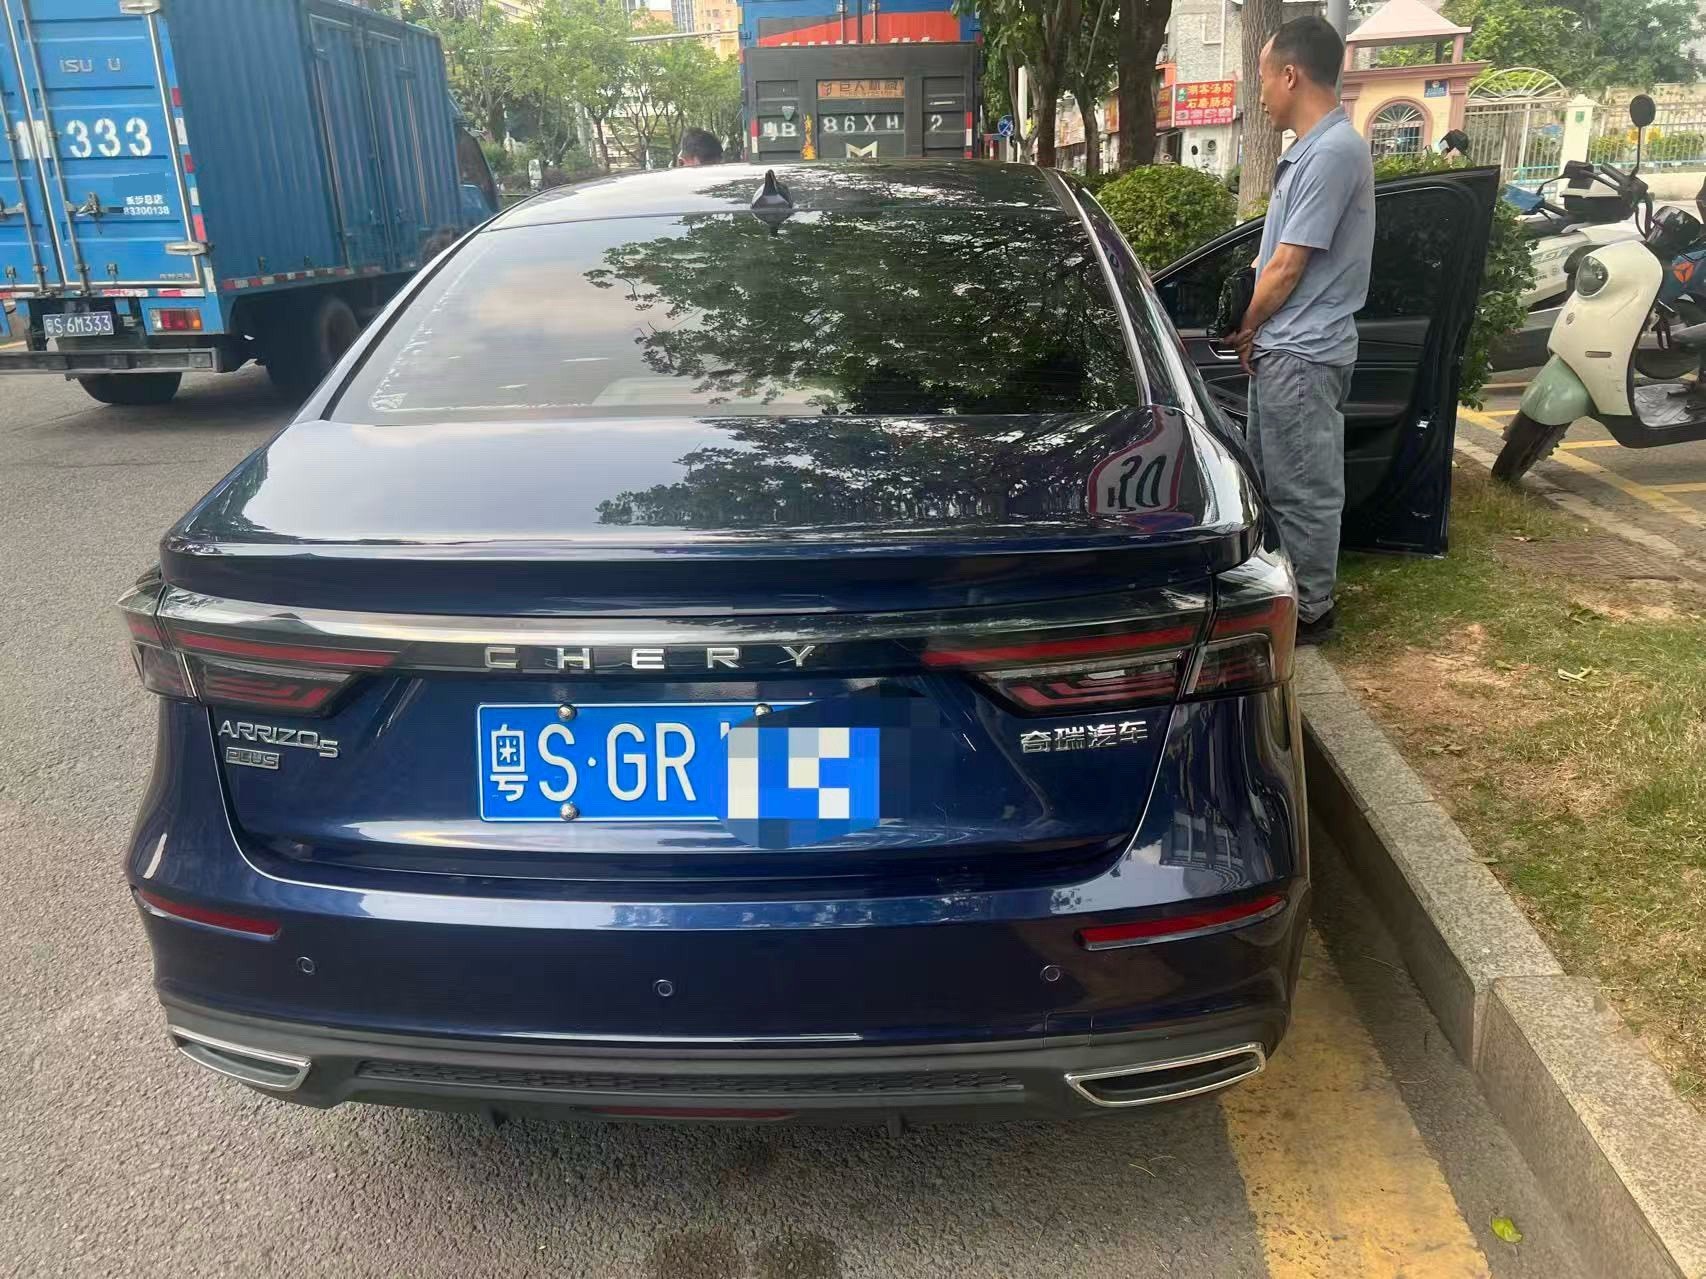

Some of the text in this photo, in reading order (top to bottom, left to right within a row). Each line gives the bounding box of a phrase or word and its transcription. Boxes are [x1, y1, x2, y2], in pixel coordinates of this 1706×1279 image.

[484, 646, 816, 670] CHERY
[1020, 720, 1149, 753] 奇瑞汽车
[227, 748, 280, 769] PLUS
